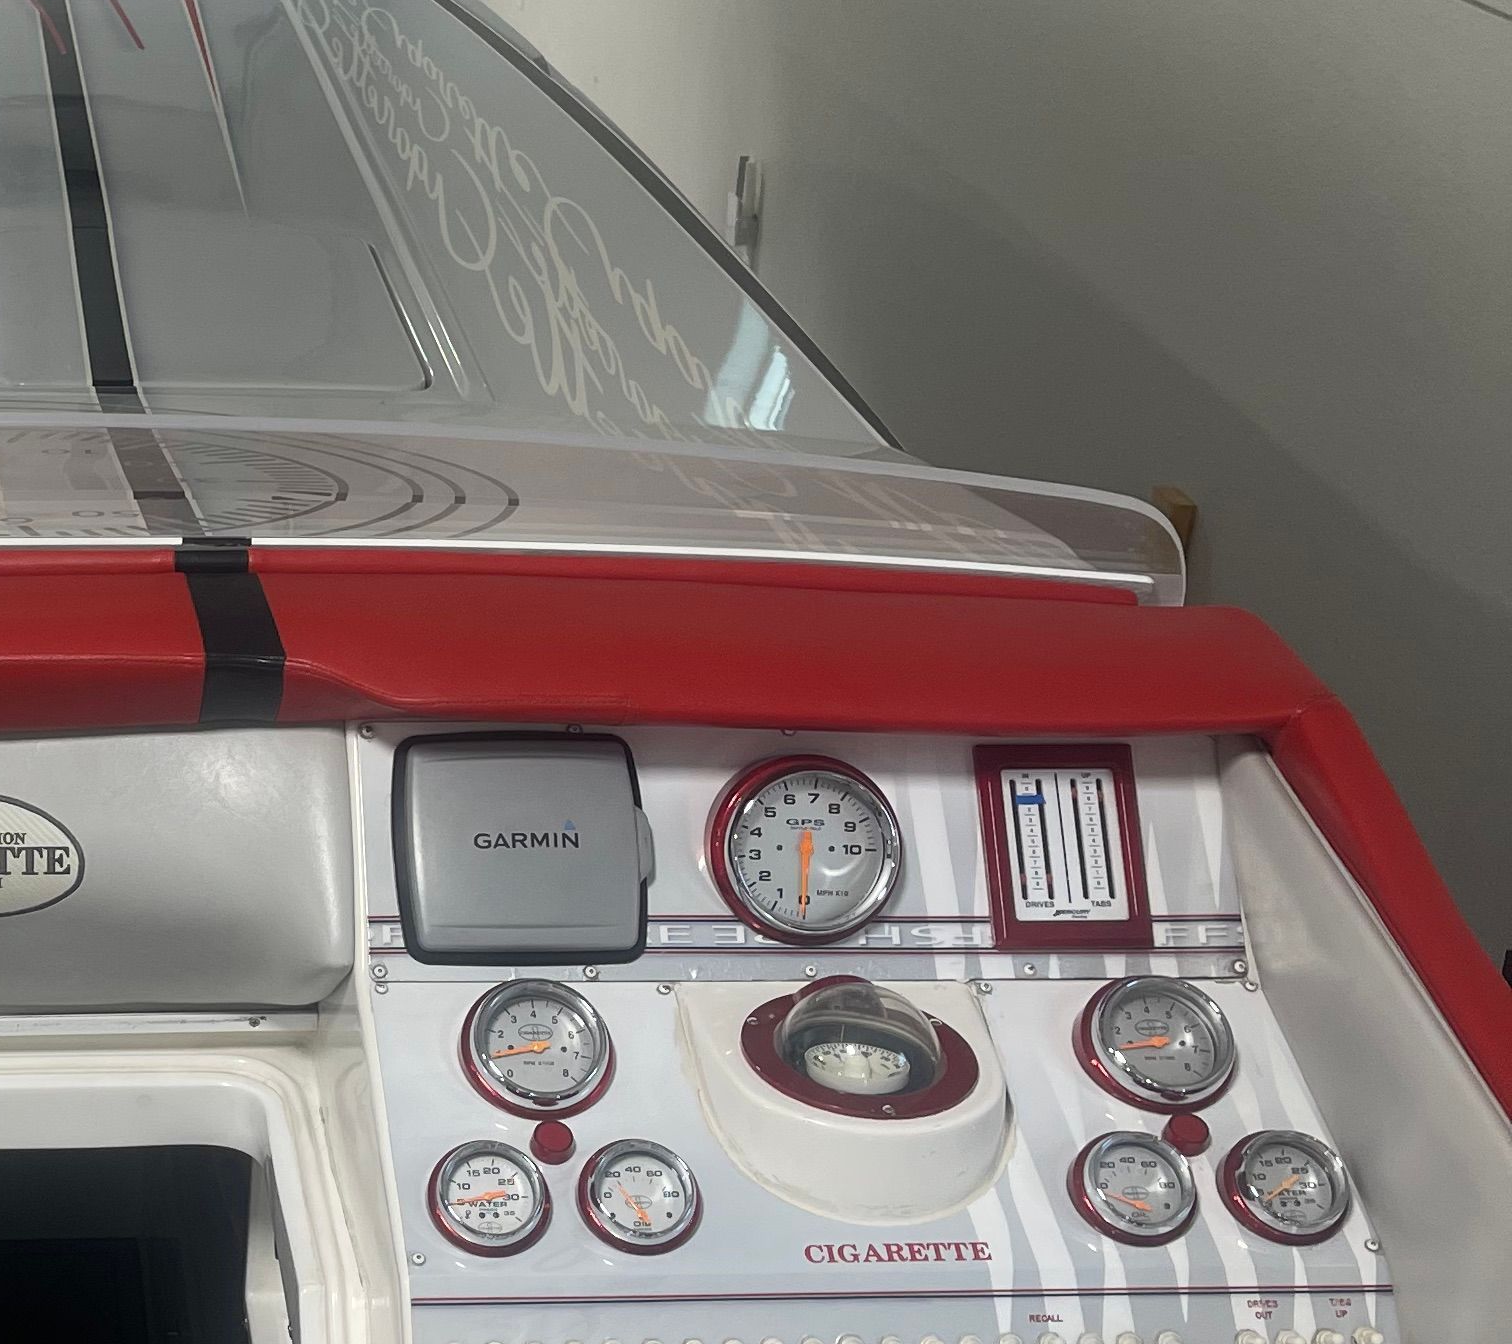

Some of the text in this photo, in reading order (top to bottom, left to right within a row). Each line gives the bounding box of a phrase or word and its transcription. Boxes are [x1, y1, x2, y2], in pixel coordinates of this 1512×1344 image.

[784, 794, 795, 804] 6
[808, 793, 820, 804] 7
[765, 807, 776, 817] 5
[829, 804, 840, 814] 8
[750, 827, 762, 837] 4
[844, 822, 856, 832] 9
[472, 832, 581, 851] GARMIN
[750, 849, 761, 860] 3
[843, 844, 861, 855] 10
[759, 871, 771, 881] 2
[777, 888, 783, 898] 1
[552, 1016, 558, 1024] 5
[568, 1031, 574, 1039] 6
[563, 1069, 569, 1077] 8
[483, 1167, 500, 1175] 20
[498, 1178, 515, 1186] 25
[502, 1193, 519, 1201] 30
[804, 1241, 992, 1263] CIGARETTE
[1255, 1311, 1272, 1319] OUT
